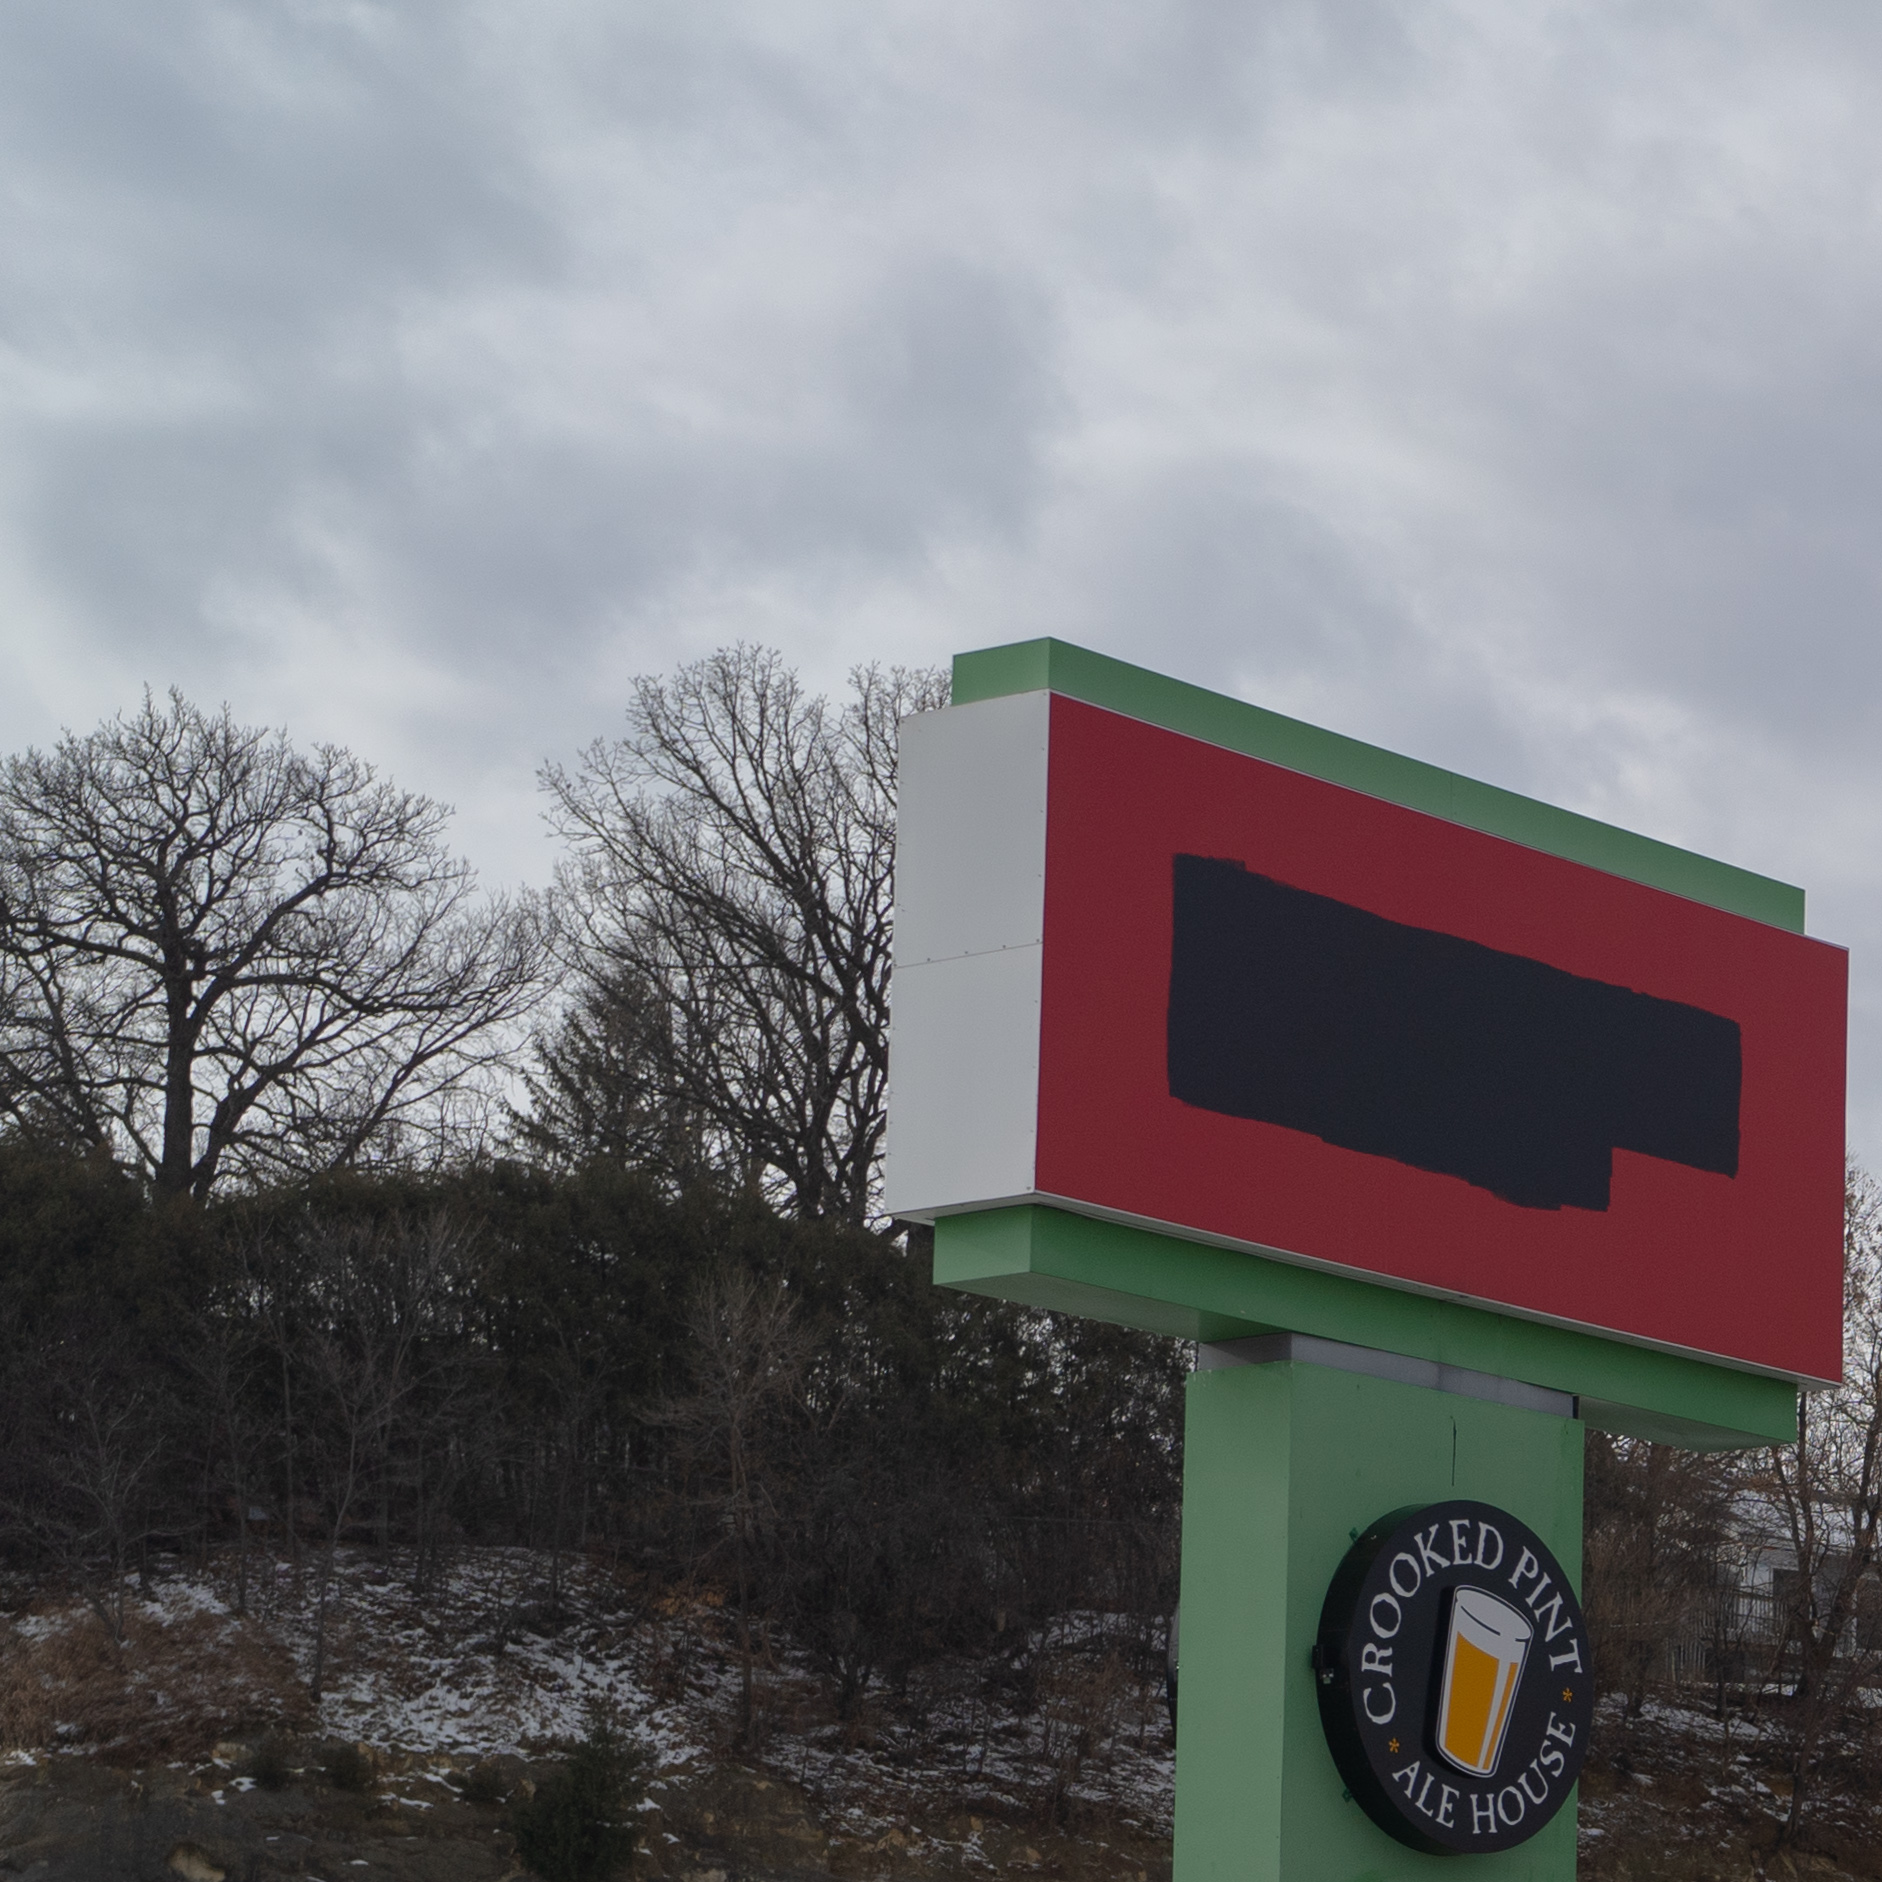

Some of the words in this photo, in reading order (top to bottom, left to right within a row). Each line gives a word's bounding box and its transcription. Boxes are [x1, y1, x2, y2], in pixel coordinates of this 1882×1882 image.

[1361, 1518, 1504, 1725] CROOKED
[1508, 1546, 1583, 1674] PINT
[1392, 1760, 1460, 1829] ALE
[1470, 1711, 1576, 1834] HOUSE
